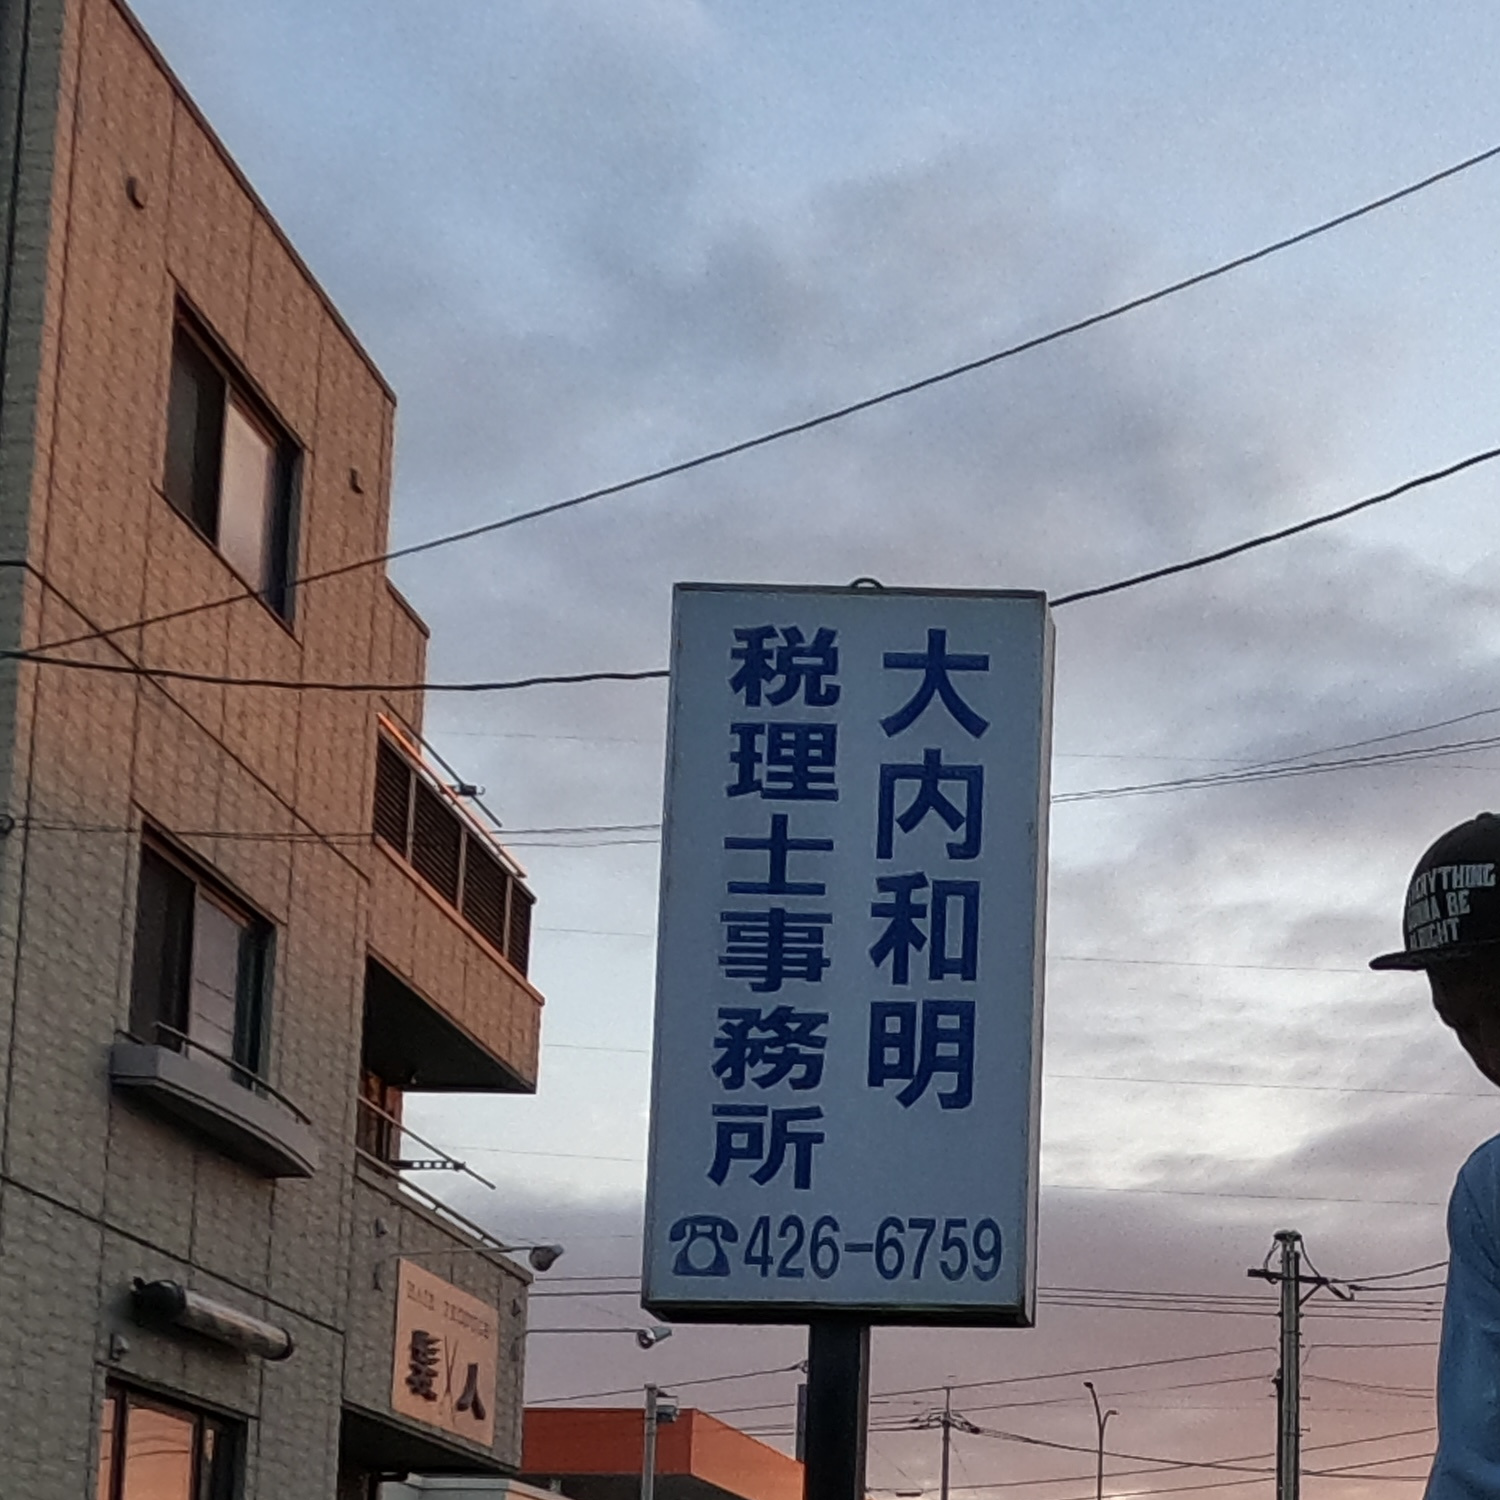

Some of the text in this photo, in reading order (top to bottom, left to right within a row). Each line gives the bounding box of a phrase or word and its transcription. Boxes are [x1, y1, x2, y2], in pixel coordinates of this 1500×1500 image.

[706, 624, 841, 1191] 税理士事務所
[866, 628, 990, 1111] 大内和明
[743, 1214, 1002, 1282] 426-6759
